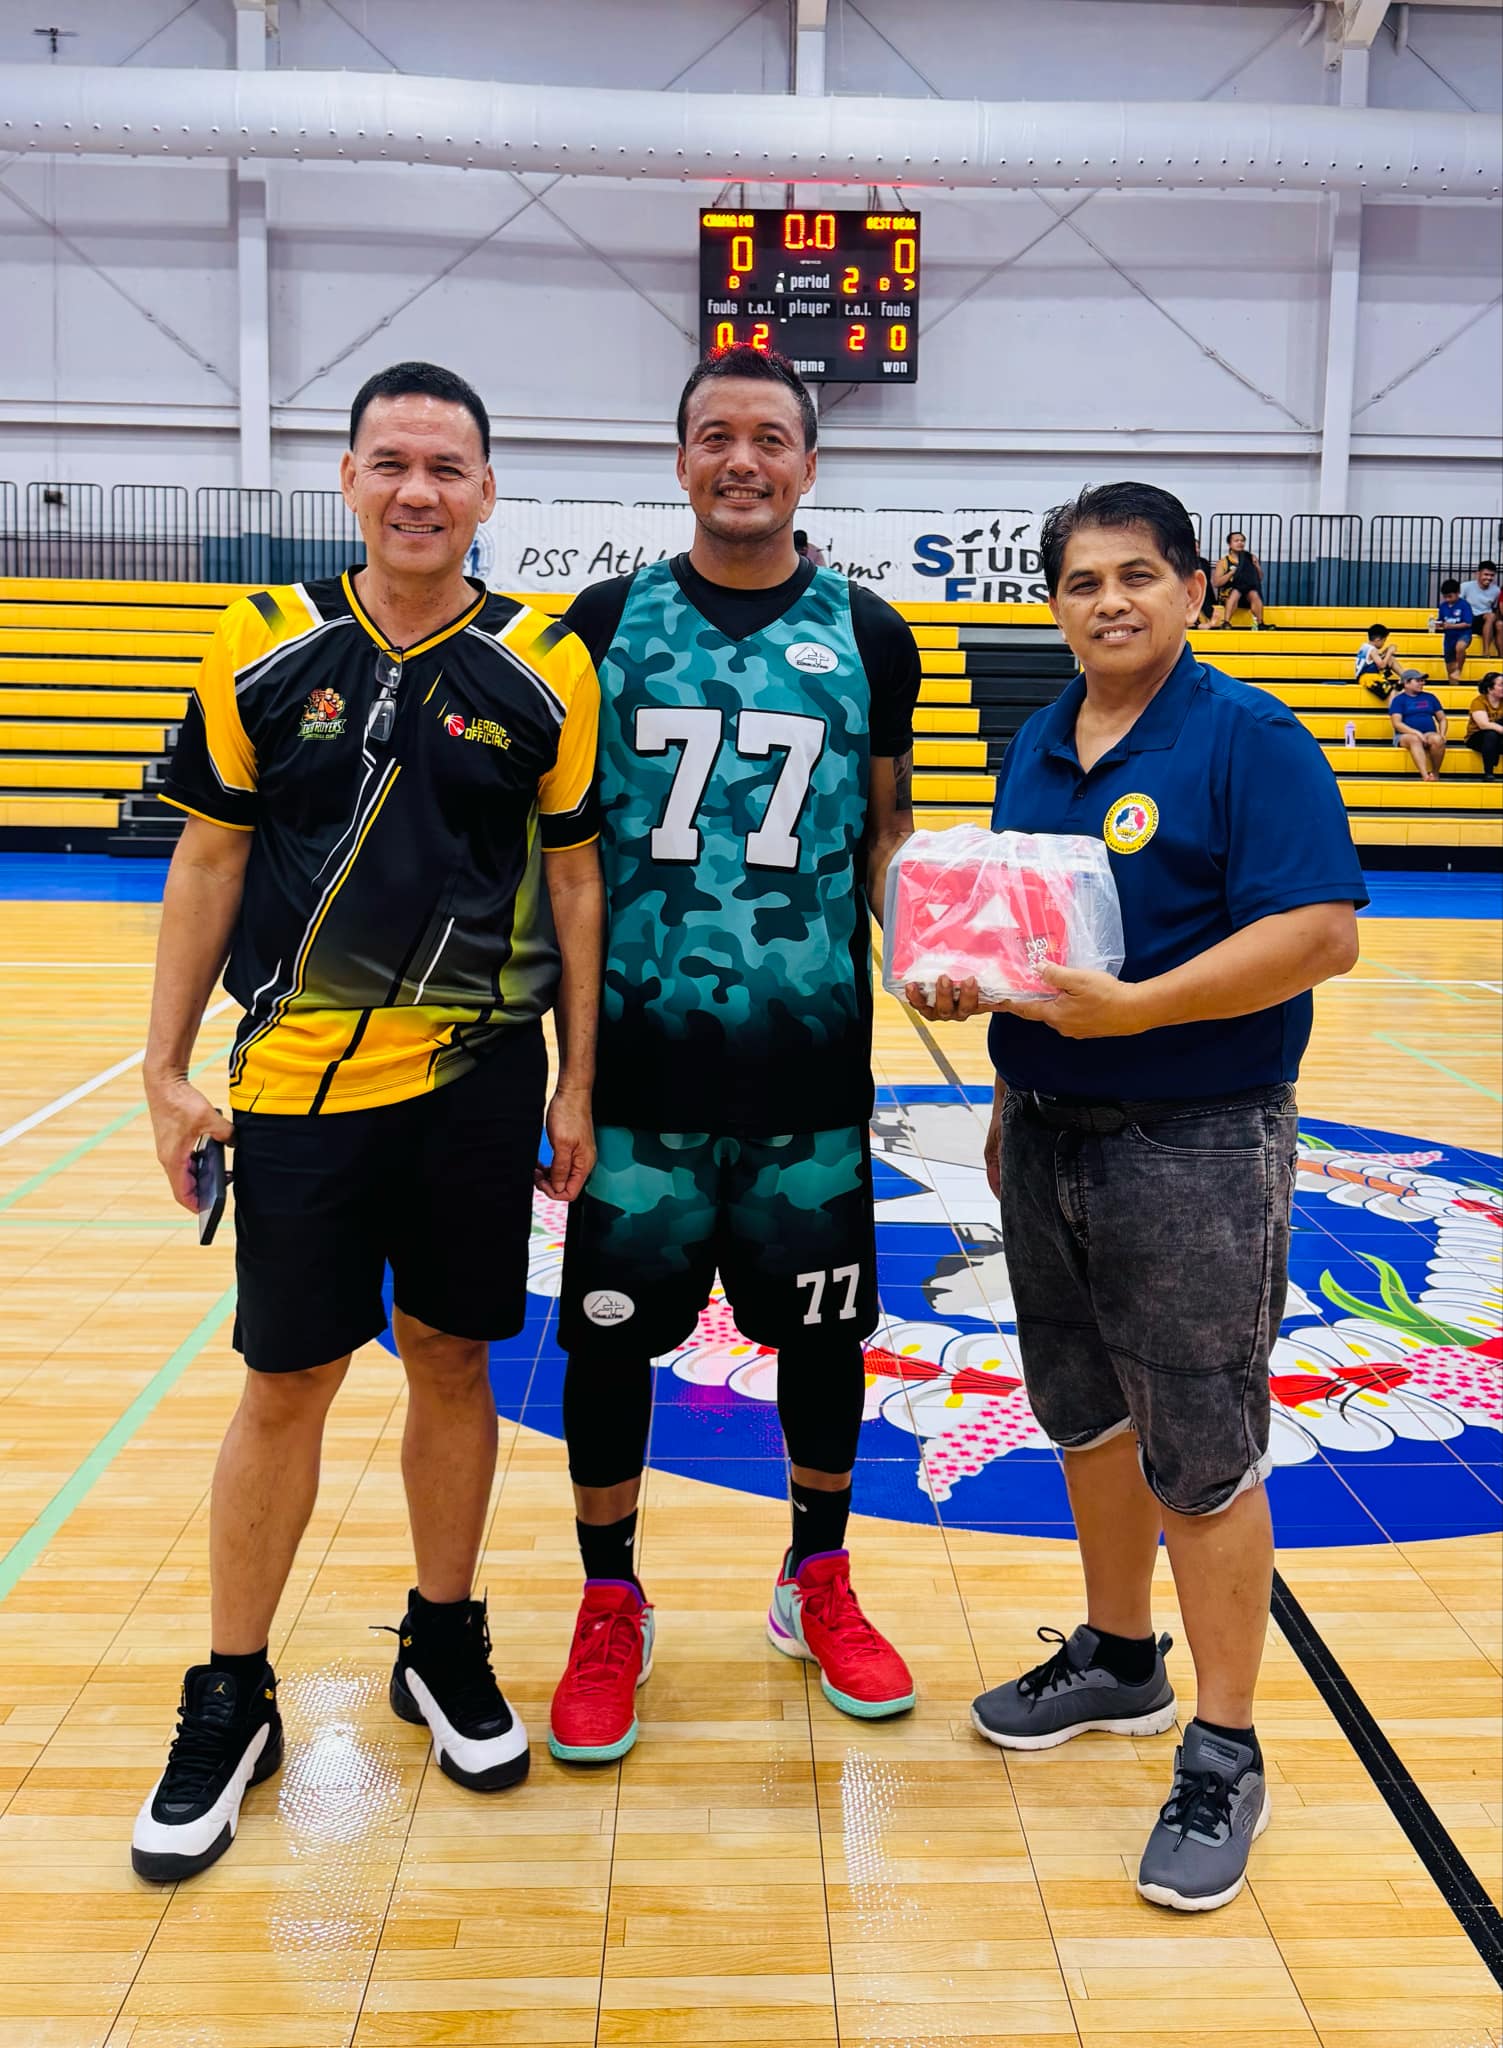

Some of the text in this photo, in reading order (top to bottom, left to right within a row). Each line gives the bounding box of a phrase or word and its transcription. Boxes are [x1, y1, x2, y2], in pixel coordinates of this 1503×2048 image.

[785, 214, 835, 249] 0.0
[732, 236, 752, 271] 0
[895, 238, 915, 273] 0
[790, 273, 830, 292] period
[842, 267, 859, 293] 2
[708, 299, 738, 314] fouls
[748, 301, 775, 315] t.o.l.
[789, 299, 830, 318] player
[845, 302, 872, 316] t.o.l.
[881, 301, 911, 317] fouls
[717, 322, 734, 348] 0
[753, 323, 769, 349] 2
[849, 325, 865, 351] 2
[890, 325, 907, 351] 0
[883, 361, 908, 373] won
[518, 547, 579, 577] PSS
[464, 727, 512, 750] OFFICIALS
[471, 717, 507, 737] LEAGUE
[636, 707, 826, 869] 77
[796, 1263, 860, 1325] 77
